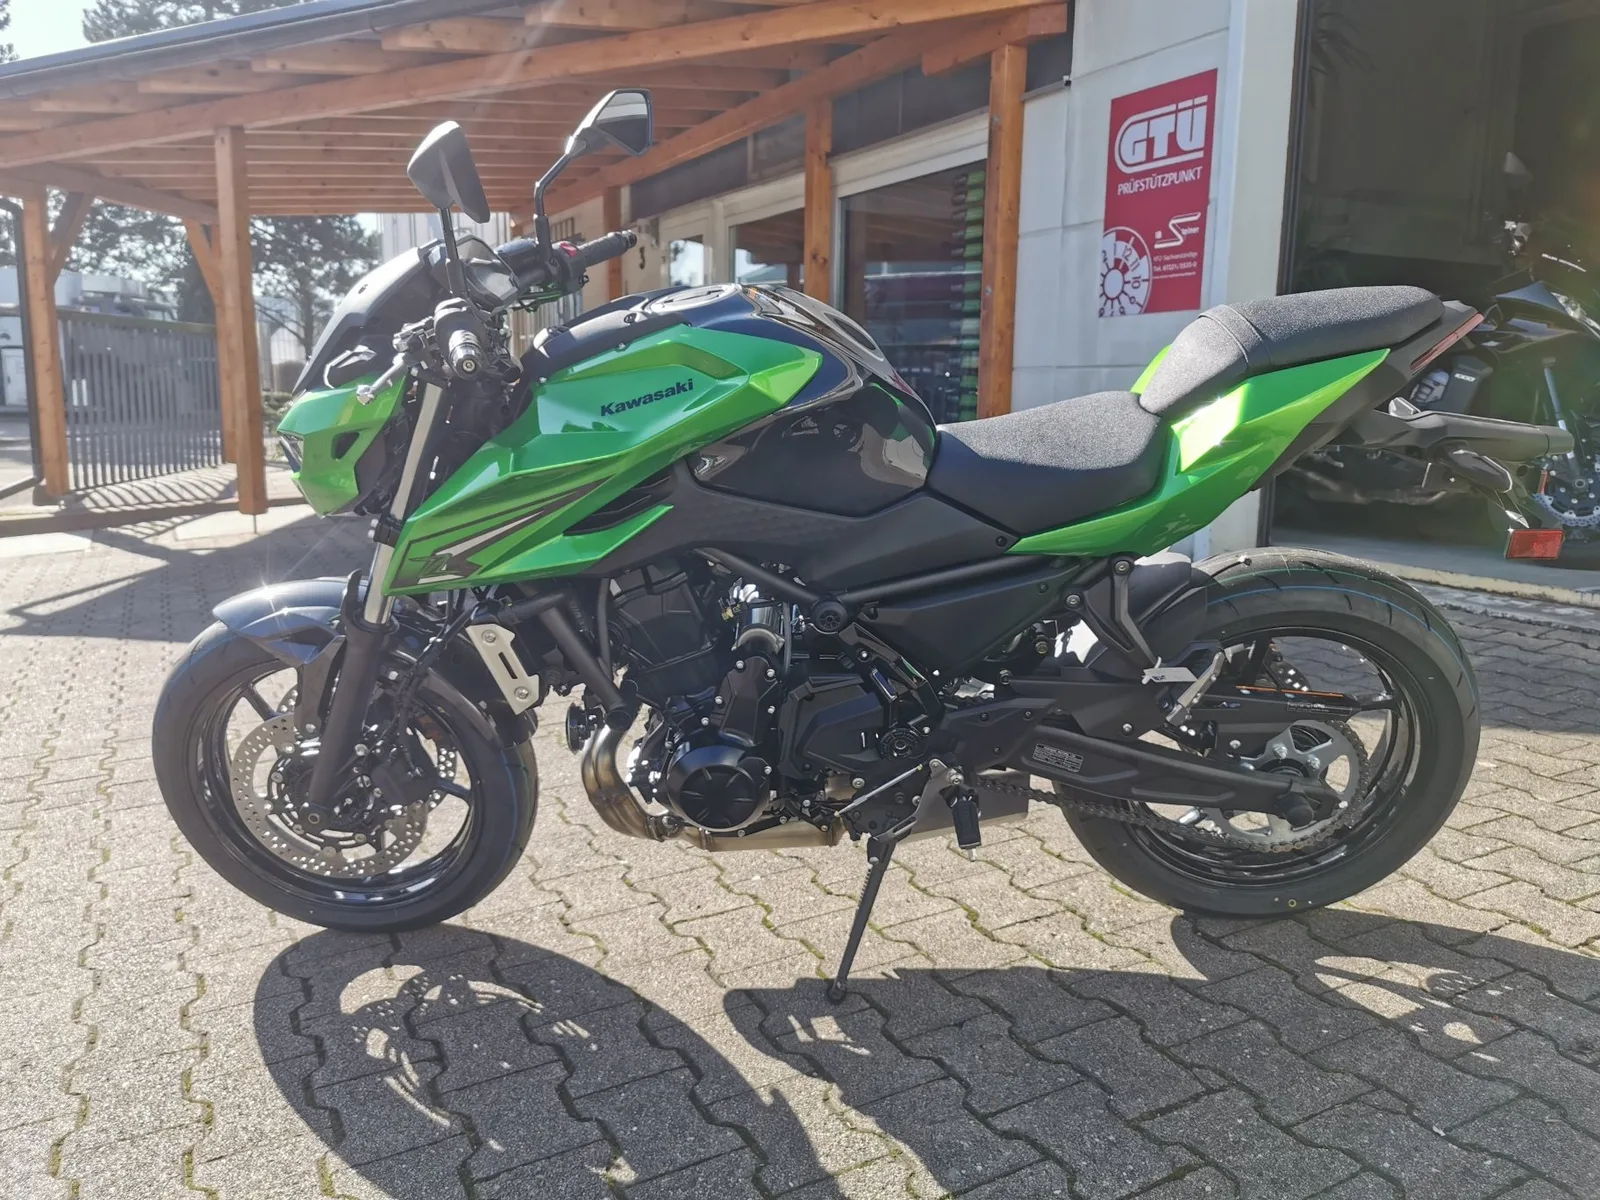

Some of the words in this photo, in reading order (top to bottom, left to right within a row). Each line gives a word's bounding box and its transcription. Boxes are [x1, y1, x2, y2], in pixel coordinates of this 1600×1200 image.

[1115, 95, 1208, 172] GTÜ
[1117, 166, 1203, 196] PRÜFSTÜTZPUNKT
[600, 378, 694, 417] Kawasaki
